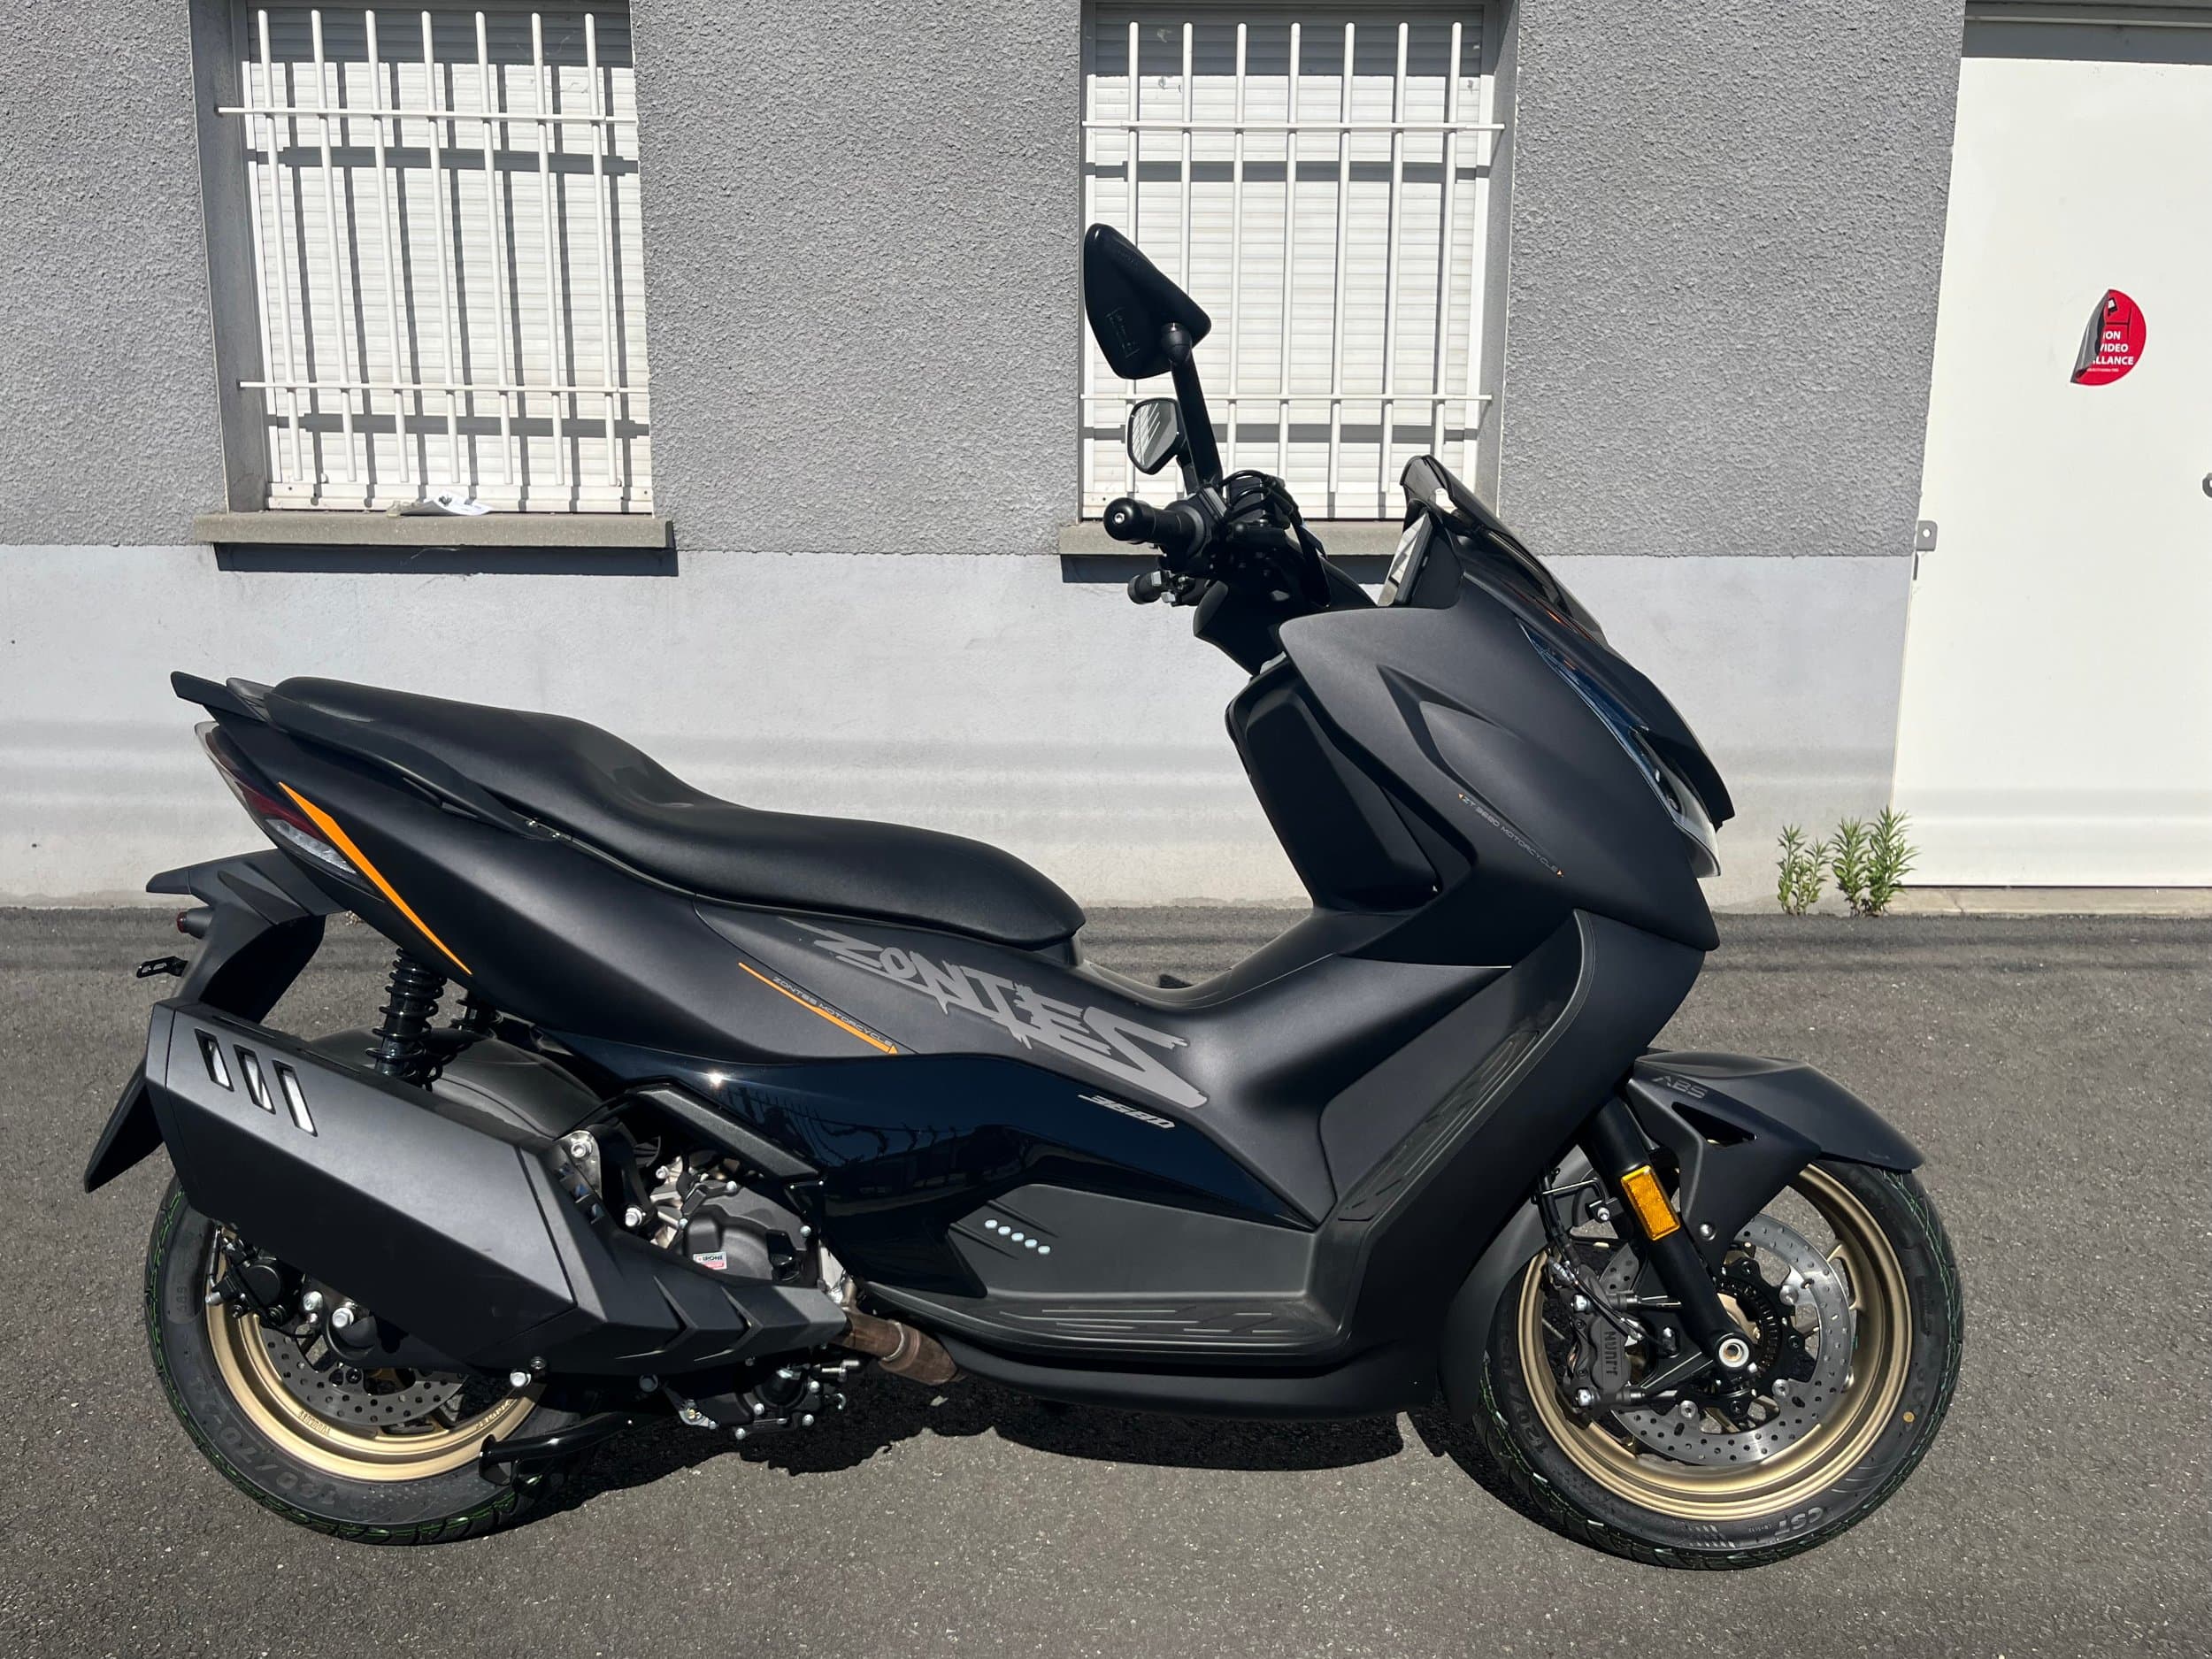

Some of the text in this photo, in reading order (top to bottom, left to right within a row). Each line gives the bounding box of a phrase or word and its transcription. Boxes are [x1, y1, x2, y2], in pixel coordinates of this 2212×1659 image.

[1500, 826, 1559, 873] MOTORCYCLE
[772, 976, 893, 1047] ZONTES MOTORCYCLE
[779, 917, 1209, 1109] ZONTES
[1651, 1075, 1708, 1099] ABS
[1774, 1506, 1824, 1536] CST
